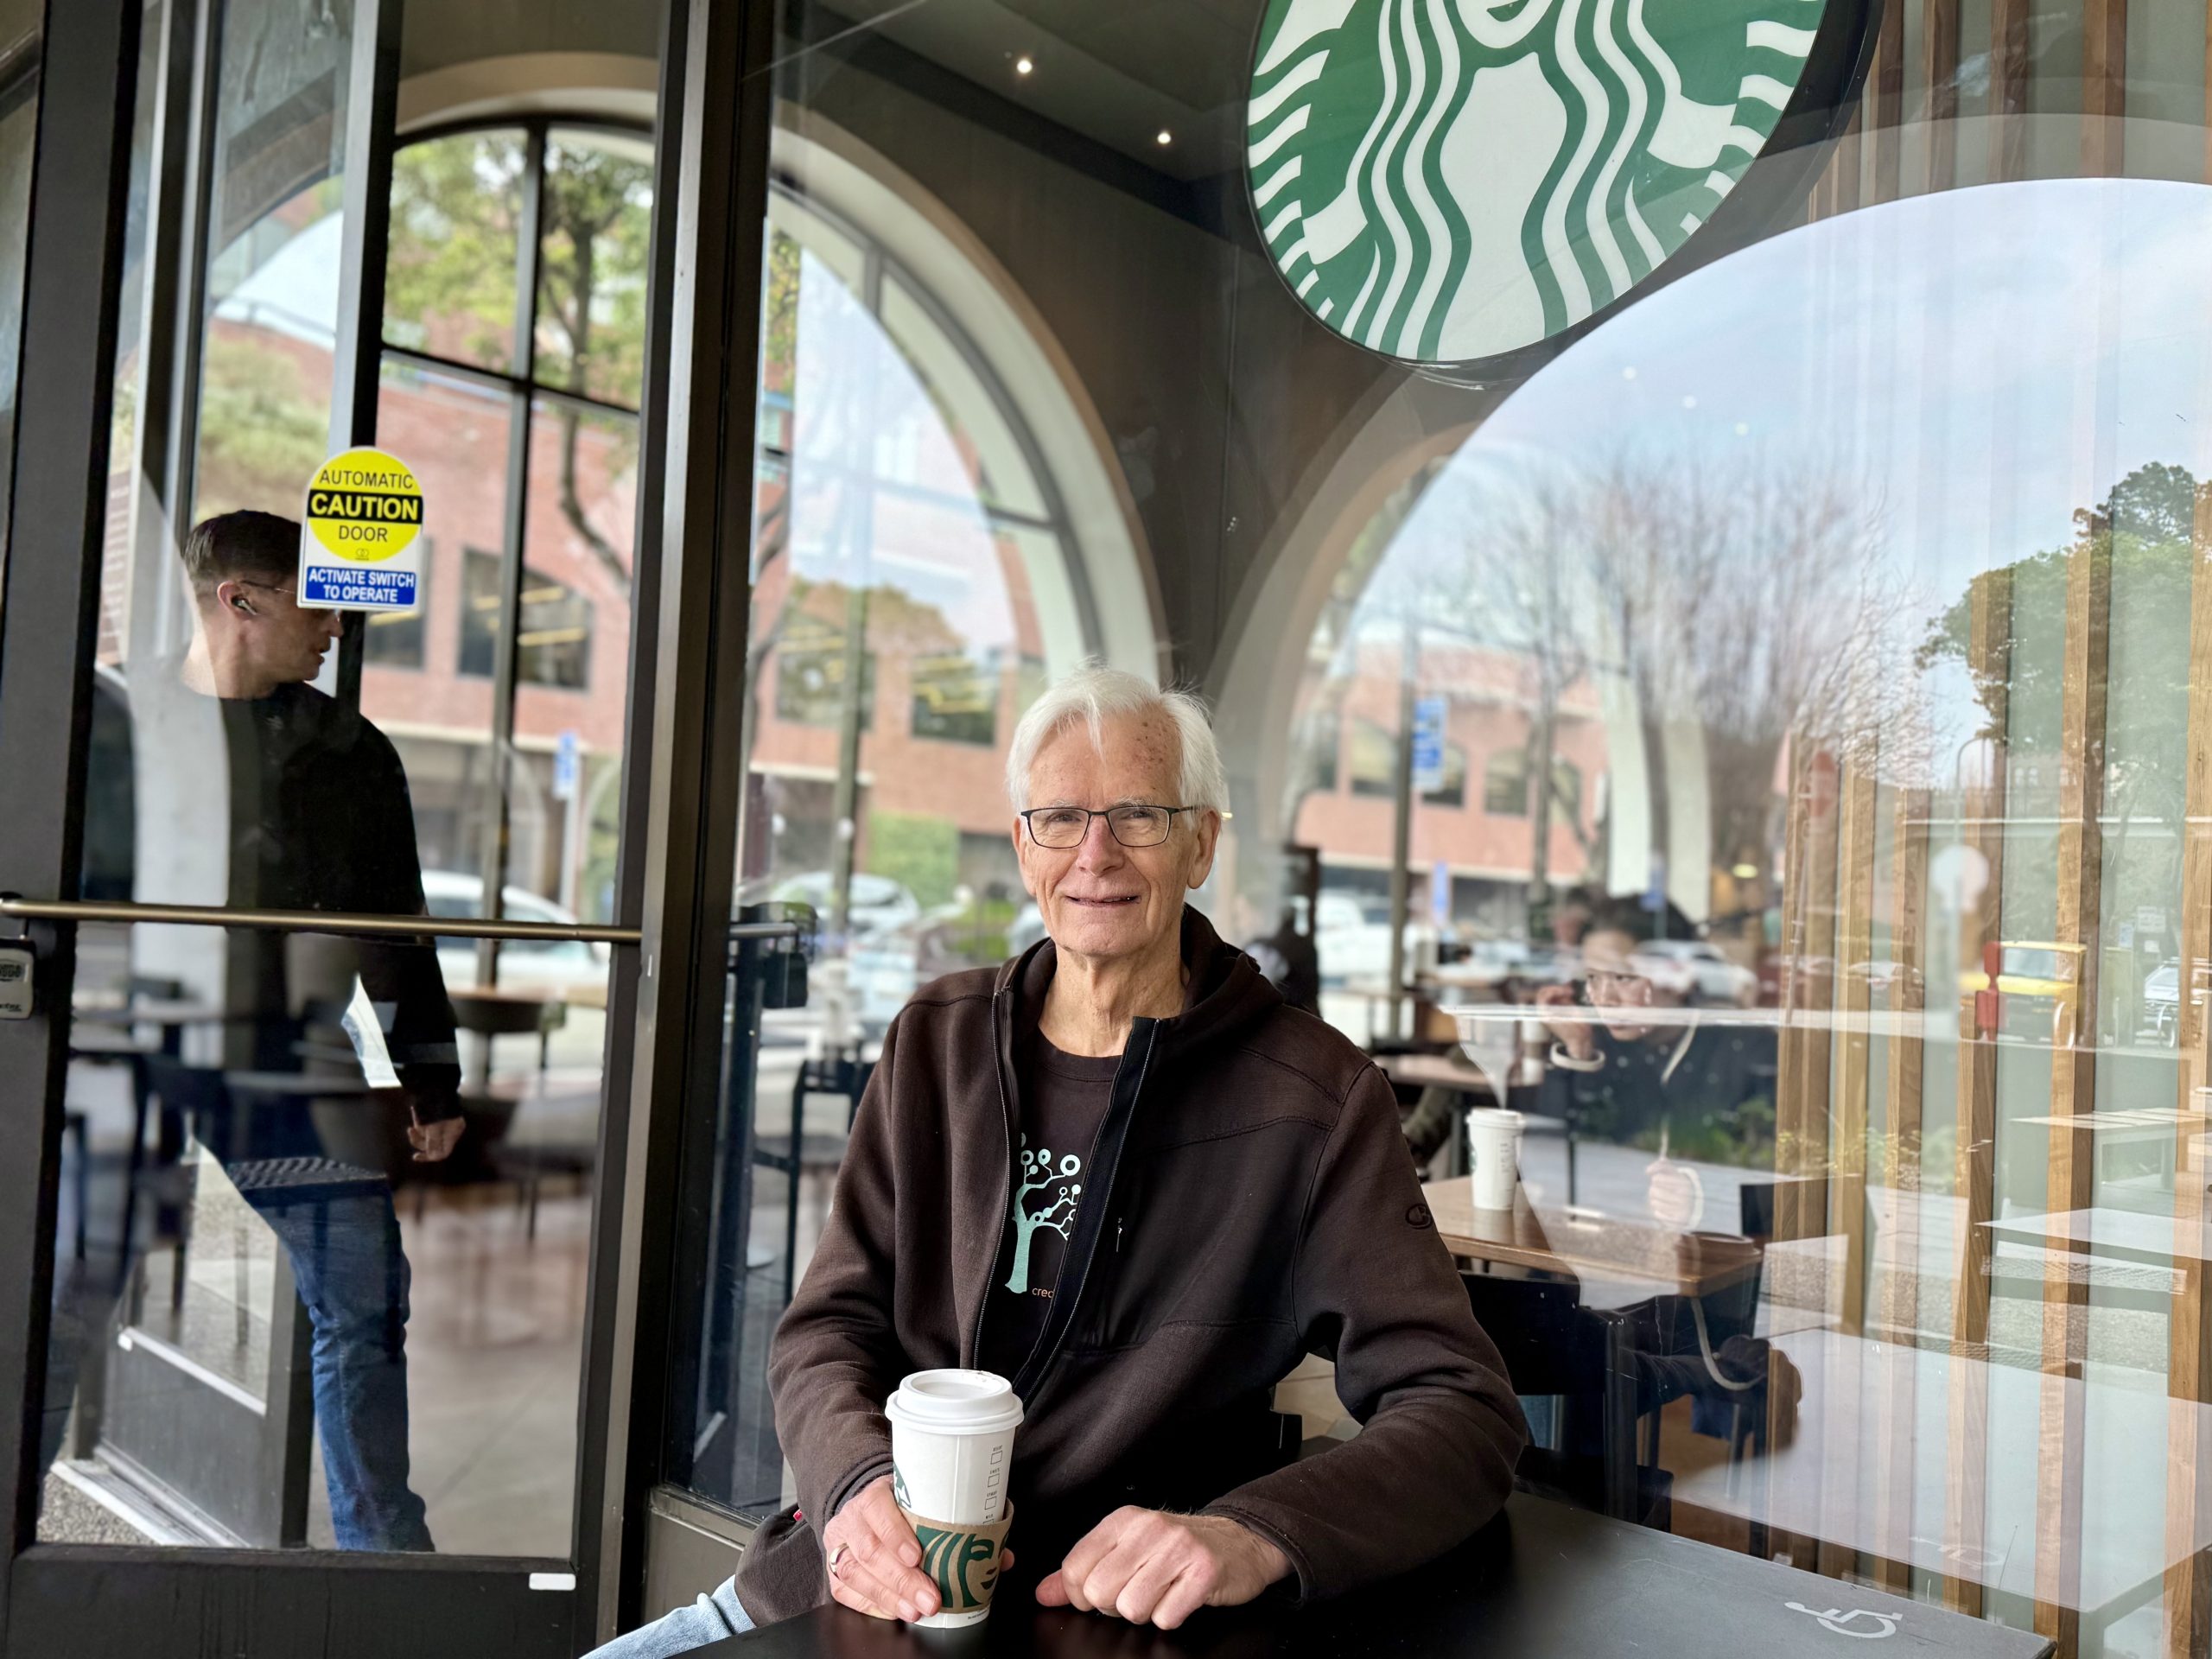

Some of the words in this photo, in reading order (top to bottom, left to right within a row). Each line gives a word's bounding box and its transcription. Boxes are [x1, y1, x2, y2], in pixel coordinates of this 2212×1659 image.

[319, 469, 413, 489] AUTOMATIC
[311, 493, 418, 520] CAUTION
[339, 525, 388, 543] DOOR
[308, 568, 365, 585] ACTIVATE
[368, 571, 415, 588] SWITCH
[323, 584, 340, 600] TO
[342, 586, 398, 603] OPERATE
